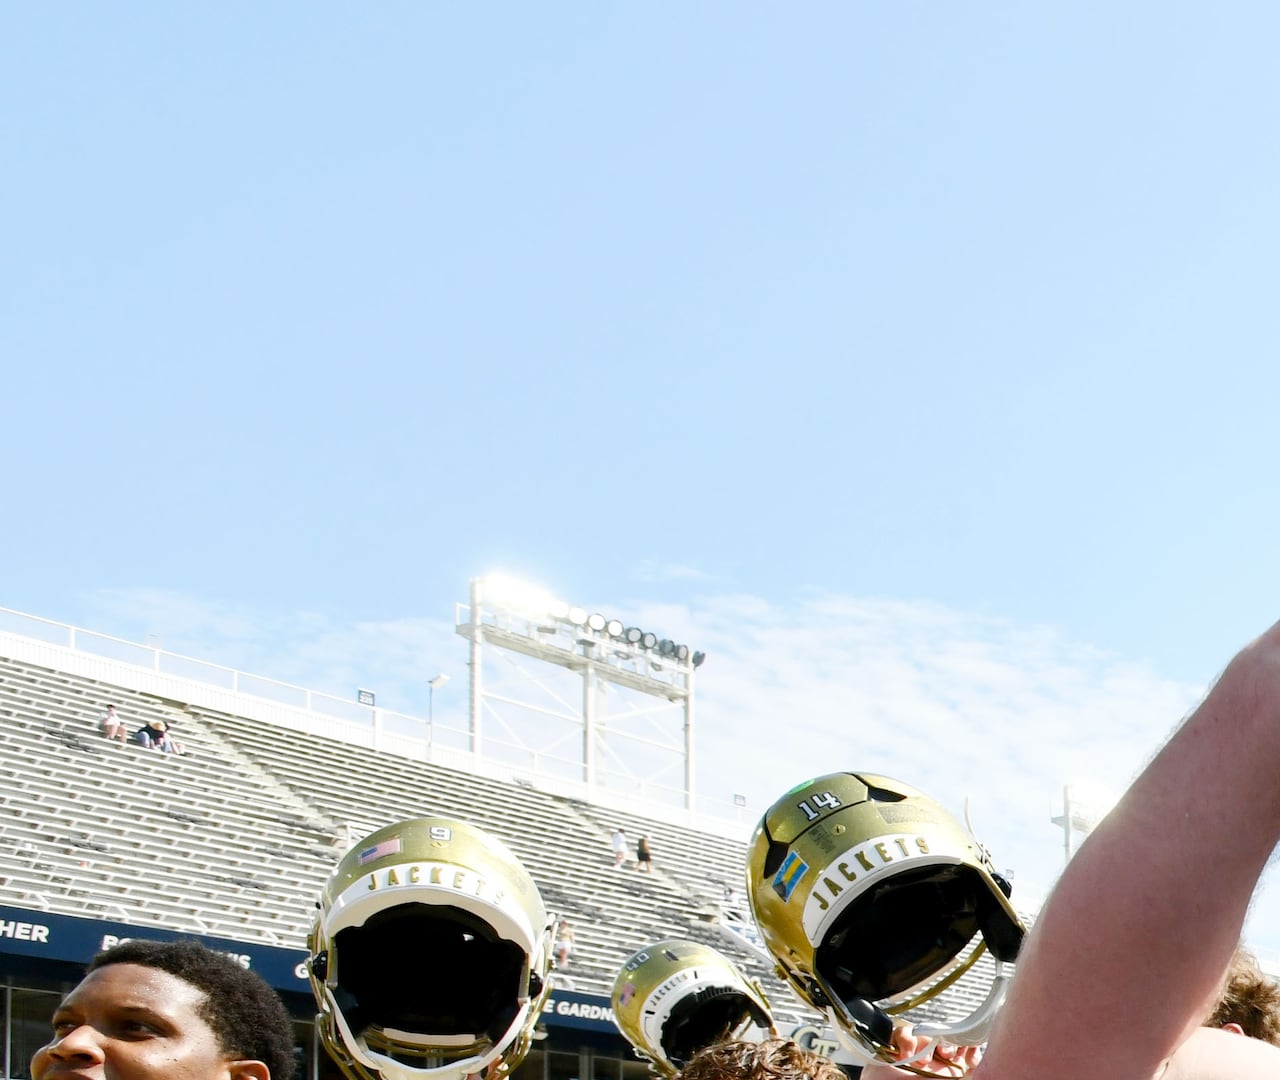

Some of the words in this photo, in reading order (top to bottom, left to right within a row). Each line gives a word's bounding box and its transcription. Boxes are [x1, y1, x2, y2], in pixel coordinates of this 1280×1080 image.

[798, 791, 842, 822] 14
[812, 836, 930, 911] JACKETS
[650, 973, 690, 1006] JACKETS
[557, 999, 618, 1024] GARDN
